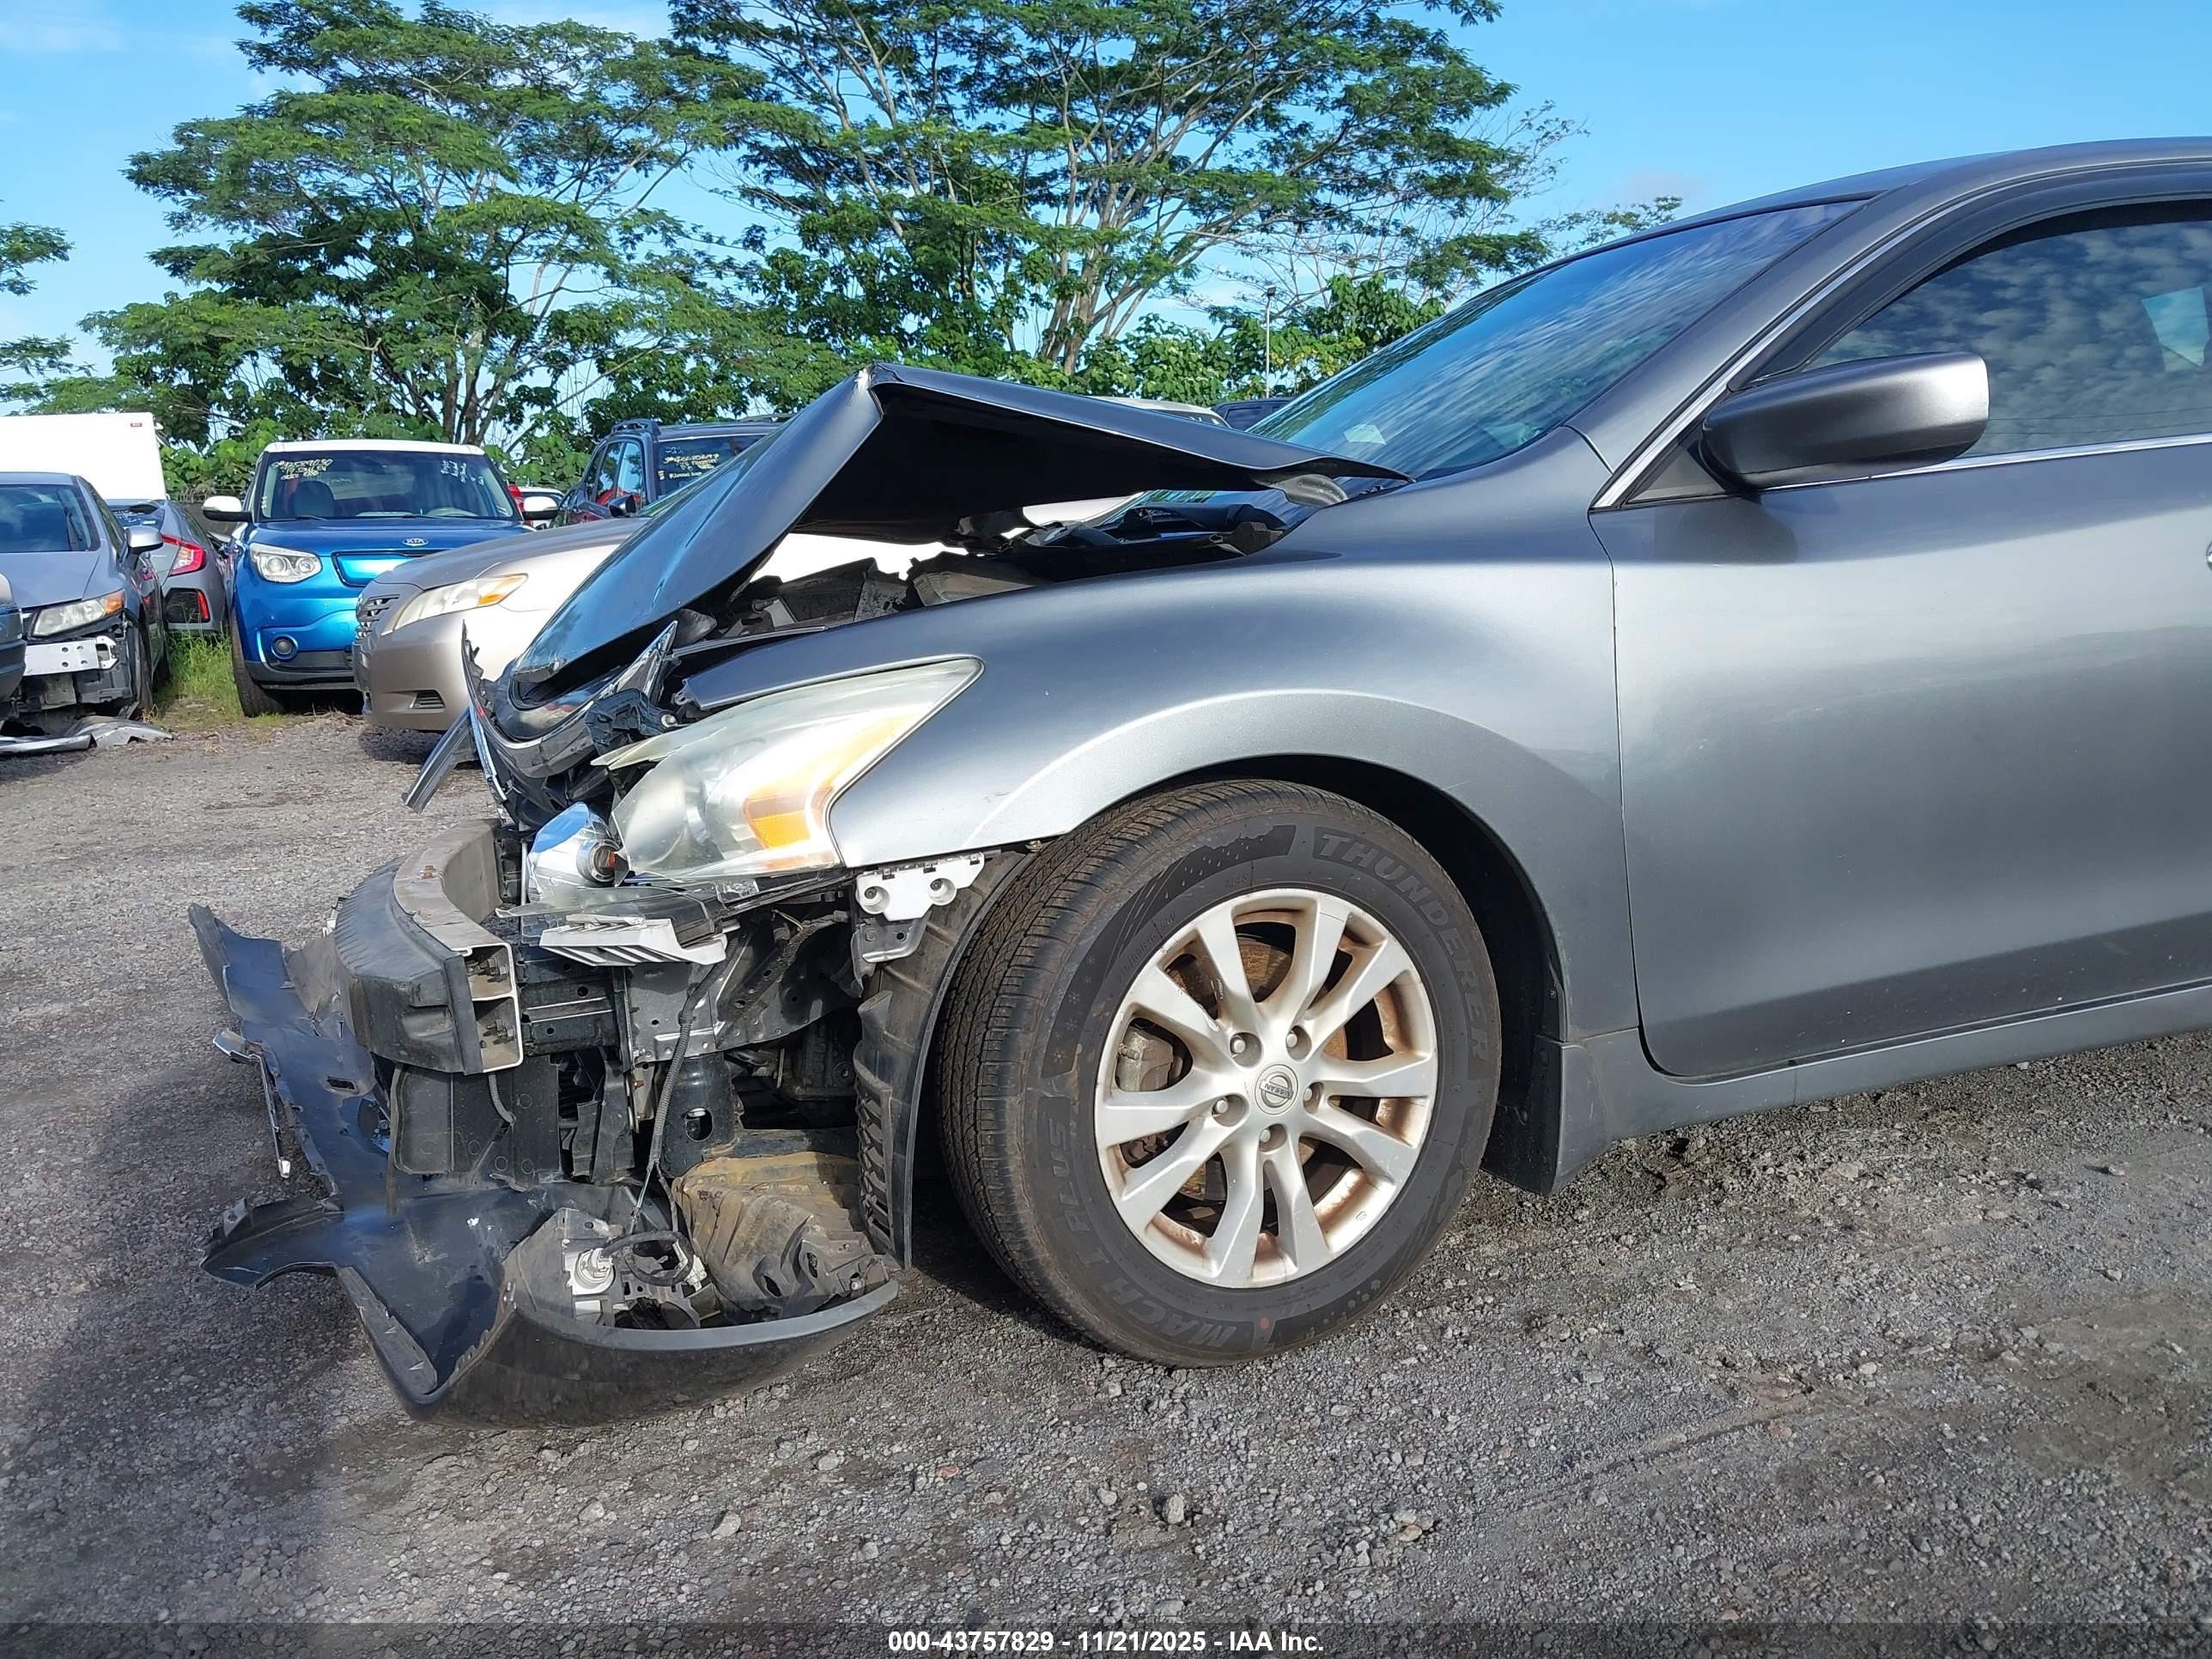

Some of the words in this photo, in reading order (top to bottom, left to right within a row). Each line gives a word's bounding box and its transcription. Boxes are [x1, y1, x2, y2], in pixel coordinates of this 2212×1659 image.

[1321, 833, 1490, 1060] THUNDERER
[1264, 1083, 1292, 1098] NISSAN
[1048, 1118, 1091, 1232] PLUS
[1105, 1277, 1238, 1347] MACH
